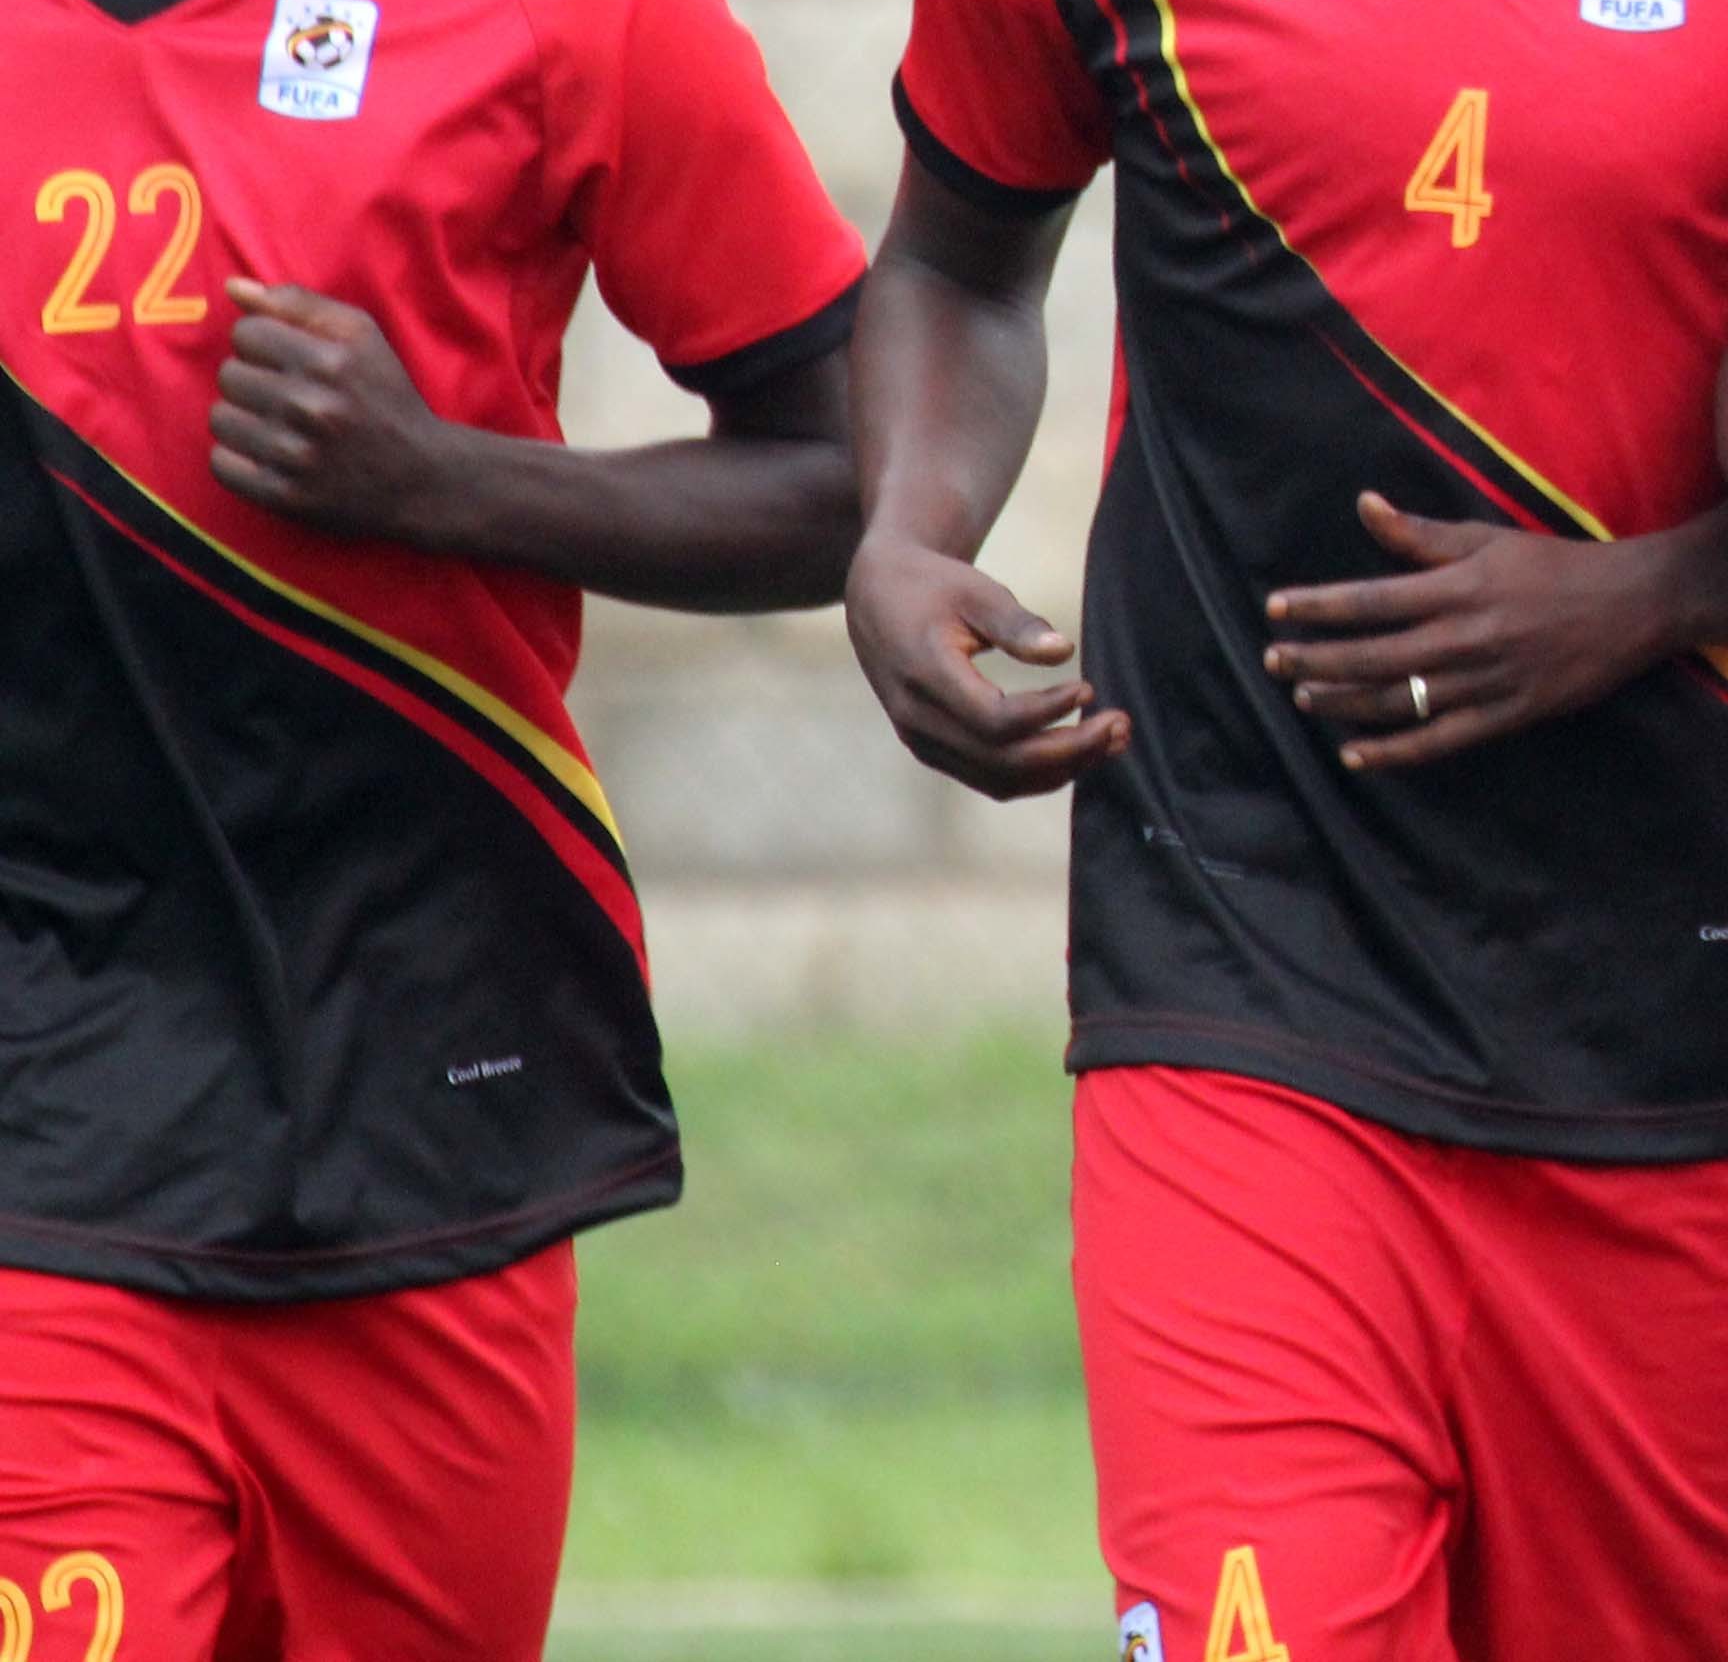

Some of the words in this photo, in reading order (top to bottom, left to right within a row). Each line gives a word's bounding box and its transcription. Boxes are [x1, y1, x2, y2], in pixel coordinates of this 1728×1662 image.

[278, 81, 339, 109] FUFA
[1404, 88, 1493, 248] 4
[35, 164, 208, 334] 22
[447, 1062, 480, 1085] Cool
